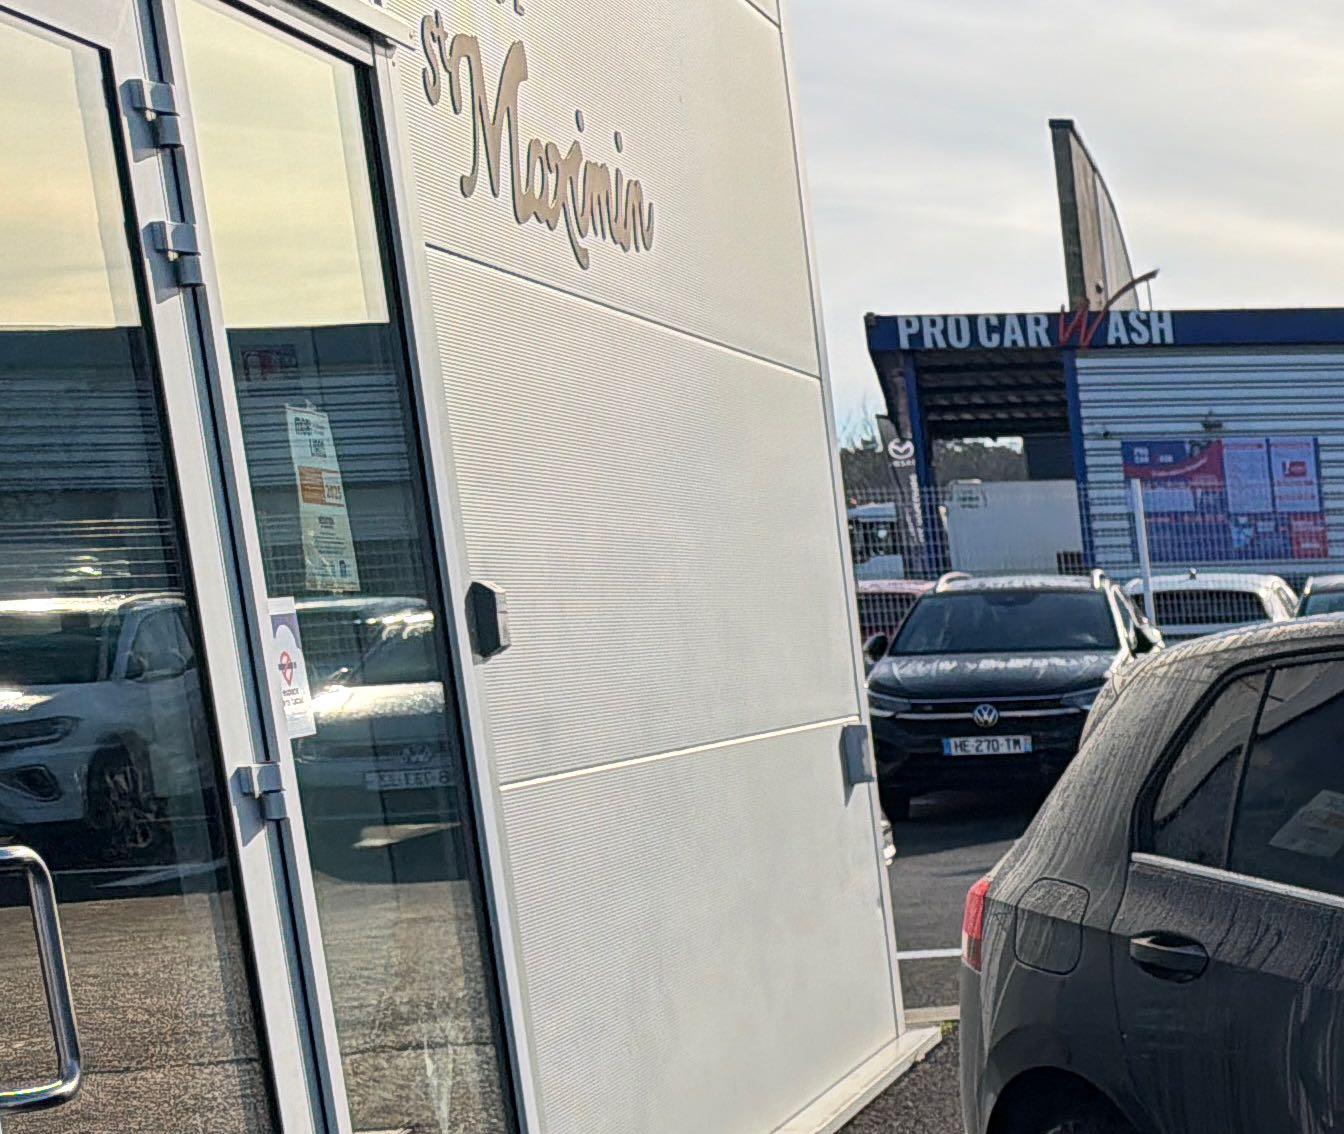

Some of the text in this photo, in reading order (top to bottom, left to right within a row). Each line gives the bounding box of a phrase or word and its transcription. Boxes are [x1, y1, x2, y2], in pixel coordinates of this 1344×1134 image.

[449, 33, 654, 270] Maximin
[897, 270, 1174, 349] PRO CAR WASH
